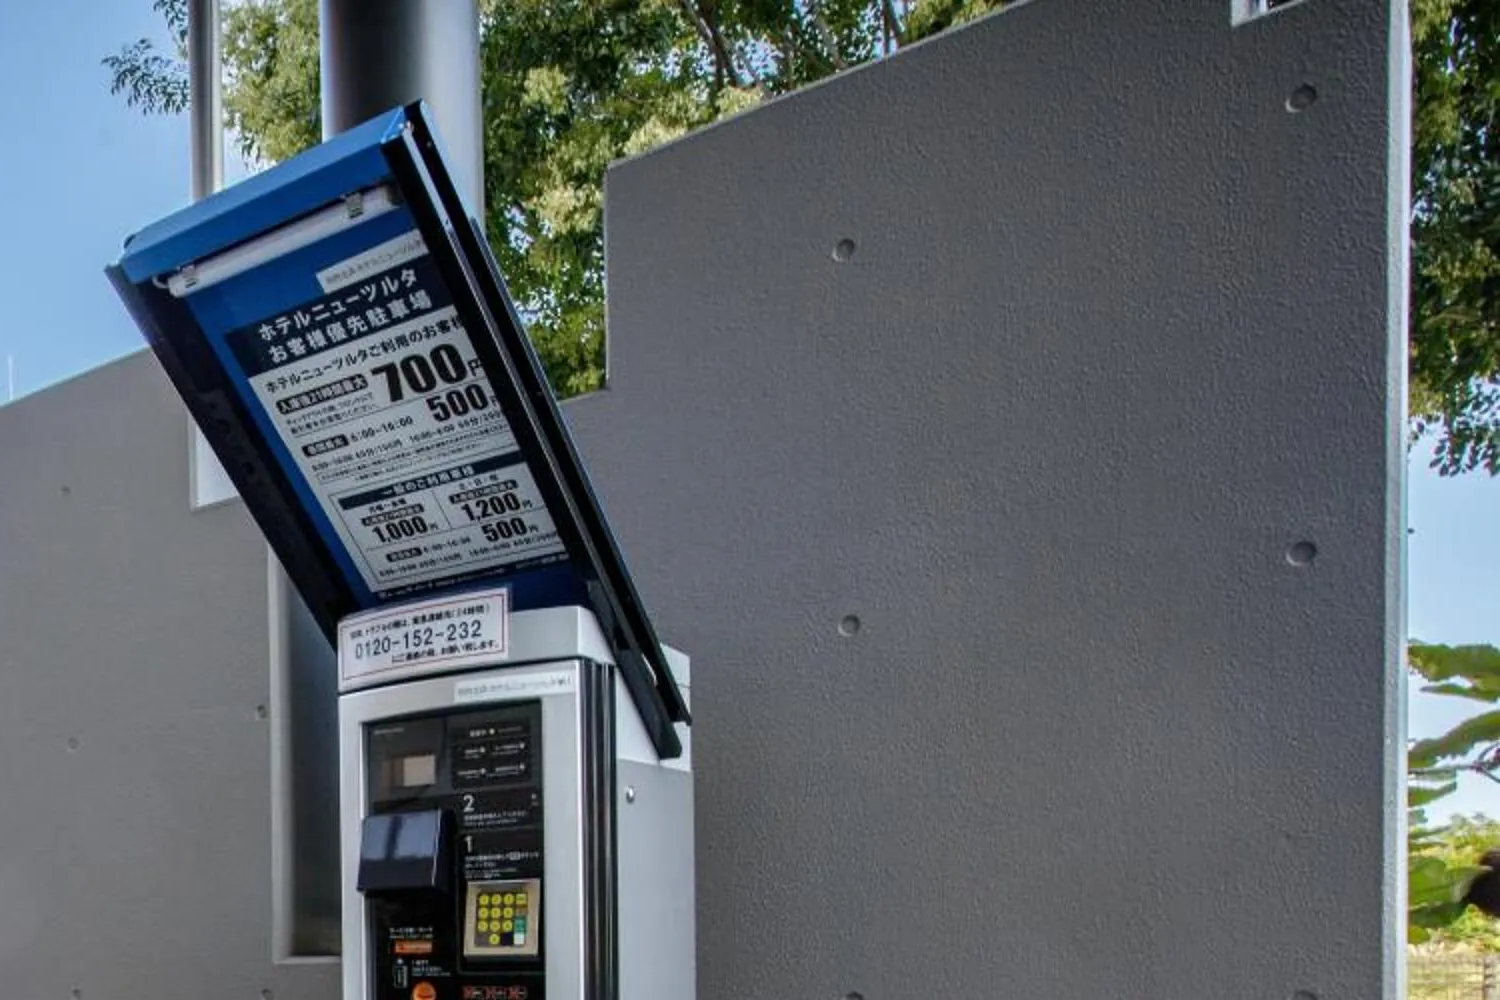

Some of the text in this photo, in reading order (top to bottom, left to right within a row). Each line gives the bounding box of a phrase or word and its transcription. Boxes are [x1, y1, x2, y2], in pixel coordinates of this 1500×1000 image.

[259, 268, 417, 341] ホテルニューツルタ
[269, 289, 432, 363] お客様優先駐車場
[356, 619, 482, 659] 0120-152-232
[463, 794, 475, 813] 2
[465, 835, 473, 853] 1
